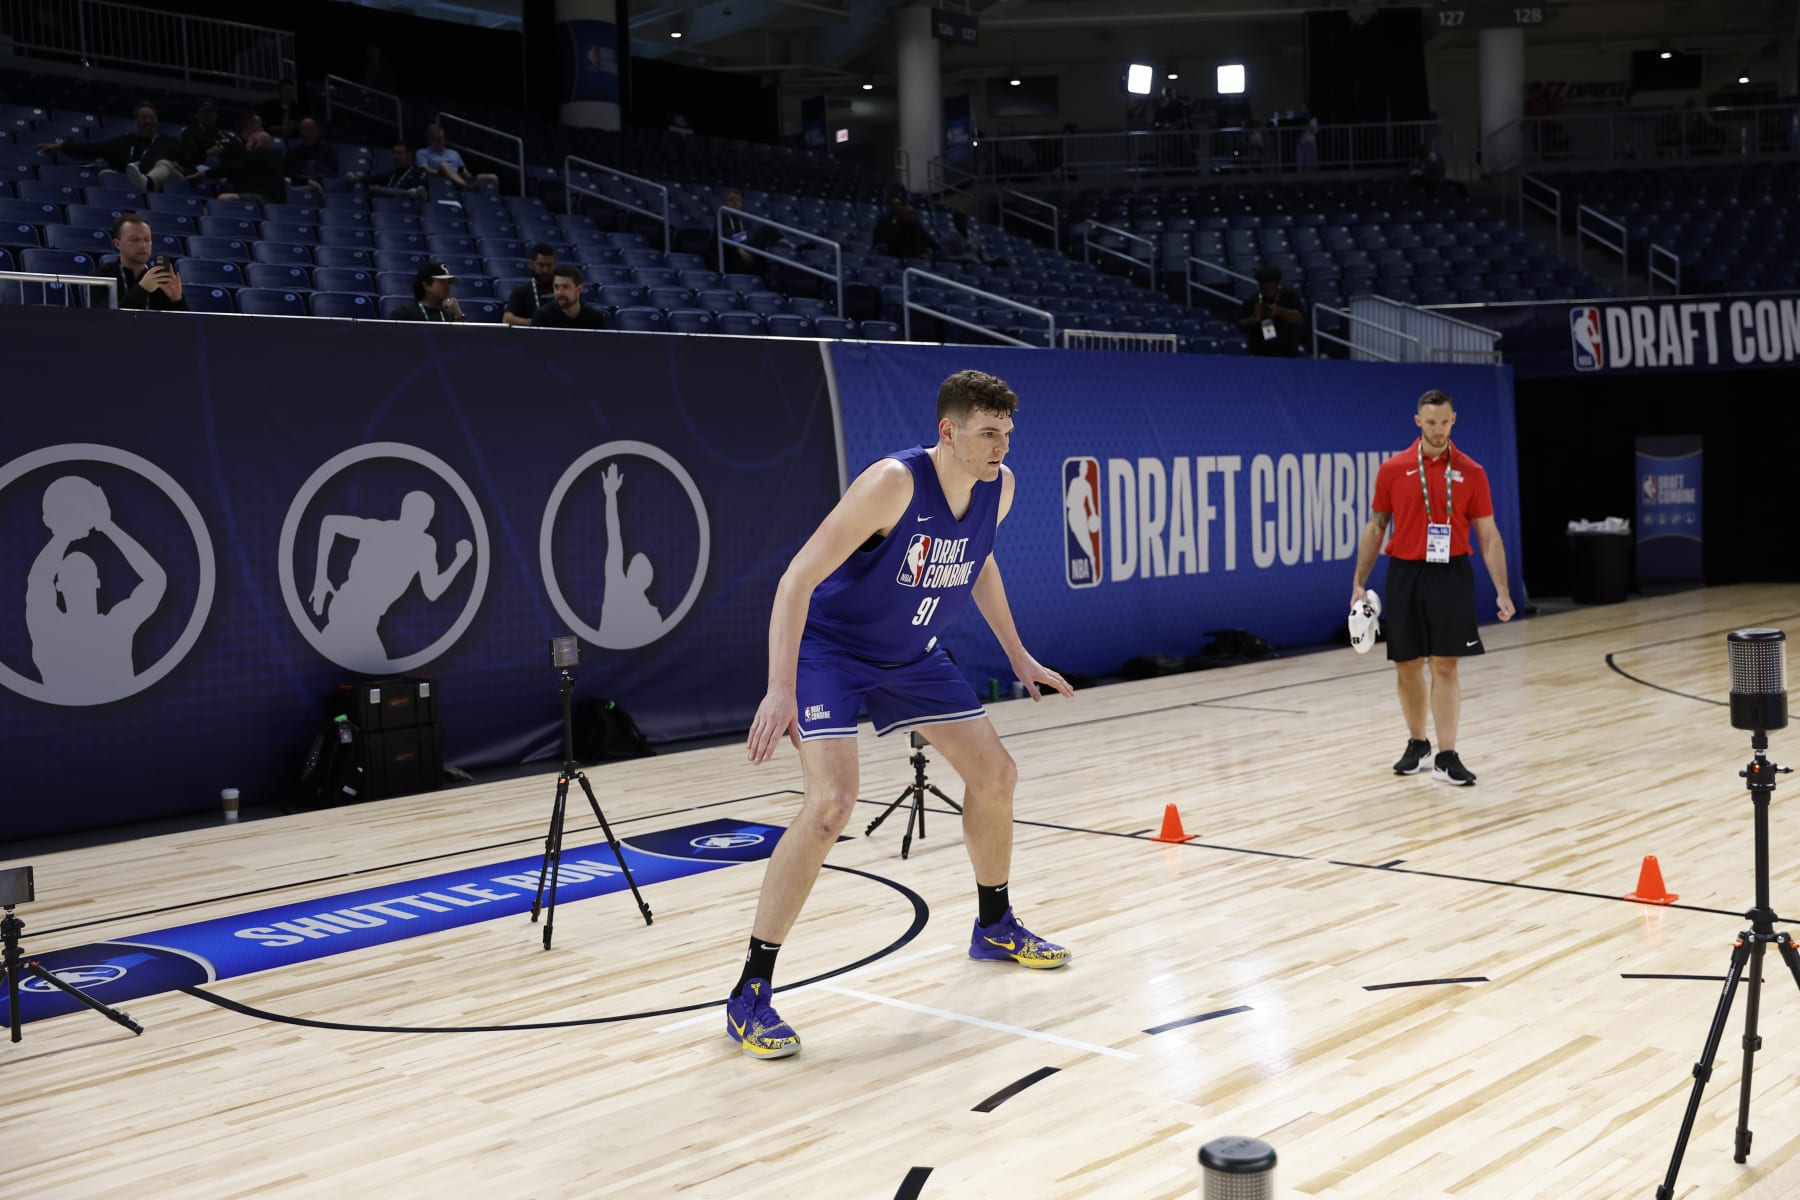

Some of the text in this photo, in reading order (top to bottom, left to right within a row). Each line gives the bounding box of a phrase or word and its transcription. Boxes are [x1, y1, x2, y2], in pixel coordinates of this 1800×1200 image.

[1438, 7, 1543, 26] 127 128
[1605, 302, 1721, 368] DRAFT
[1657, 474, 1685, 489] DRAFT
[1108, 450, 1405, 582] DRAFT COMBI
[930, 537, 969, 564] DRAFT
[899, 572, 913, 584] NBA
[922, 560, 976, 589] COMBINE
[1071, 557, 1090, 580] NBA
[911, 596, 941, 626] 91
[234, 859, 635, 947] SHUTTLE RUN
